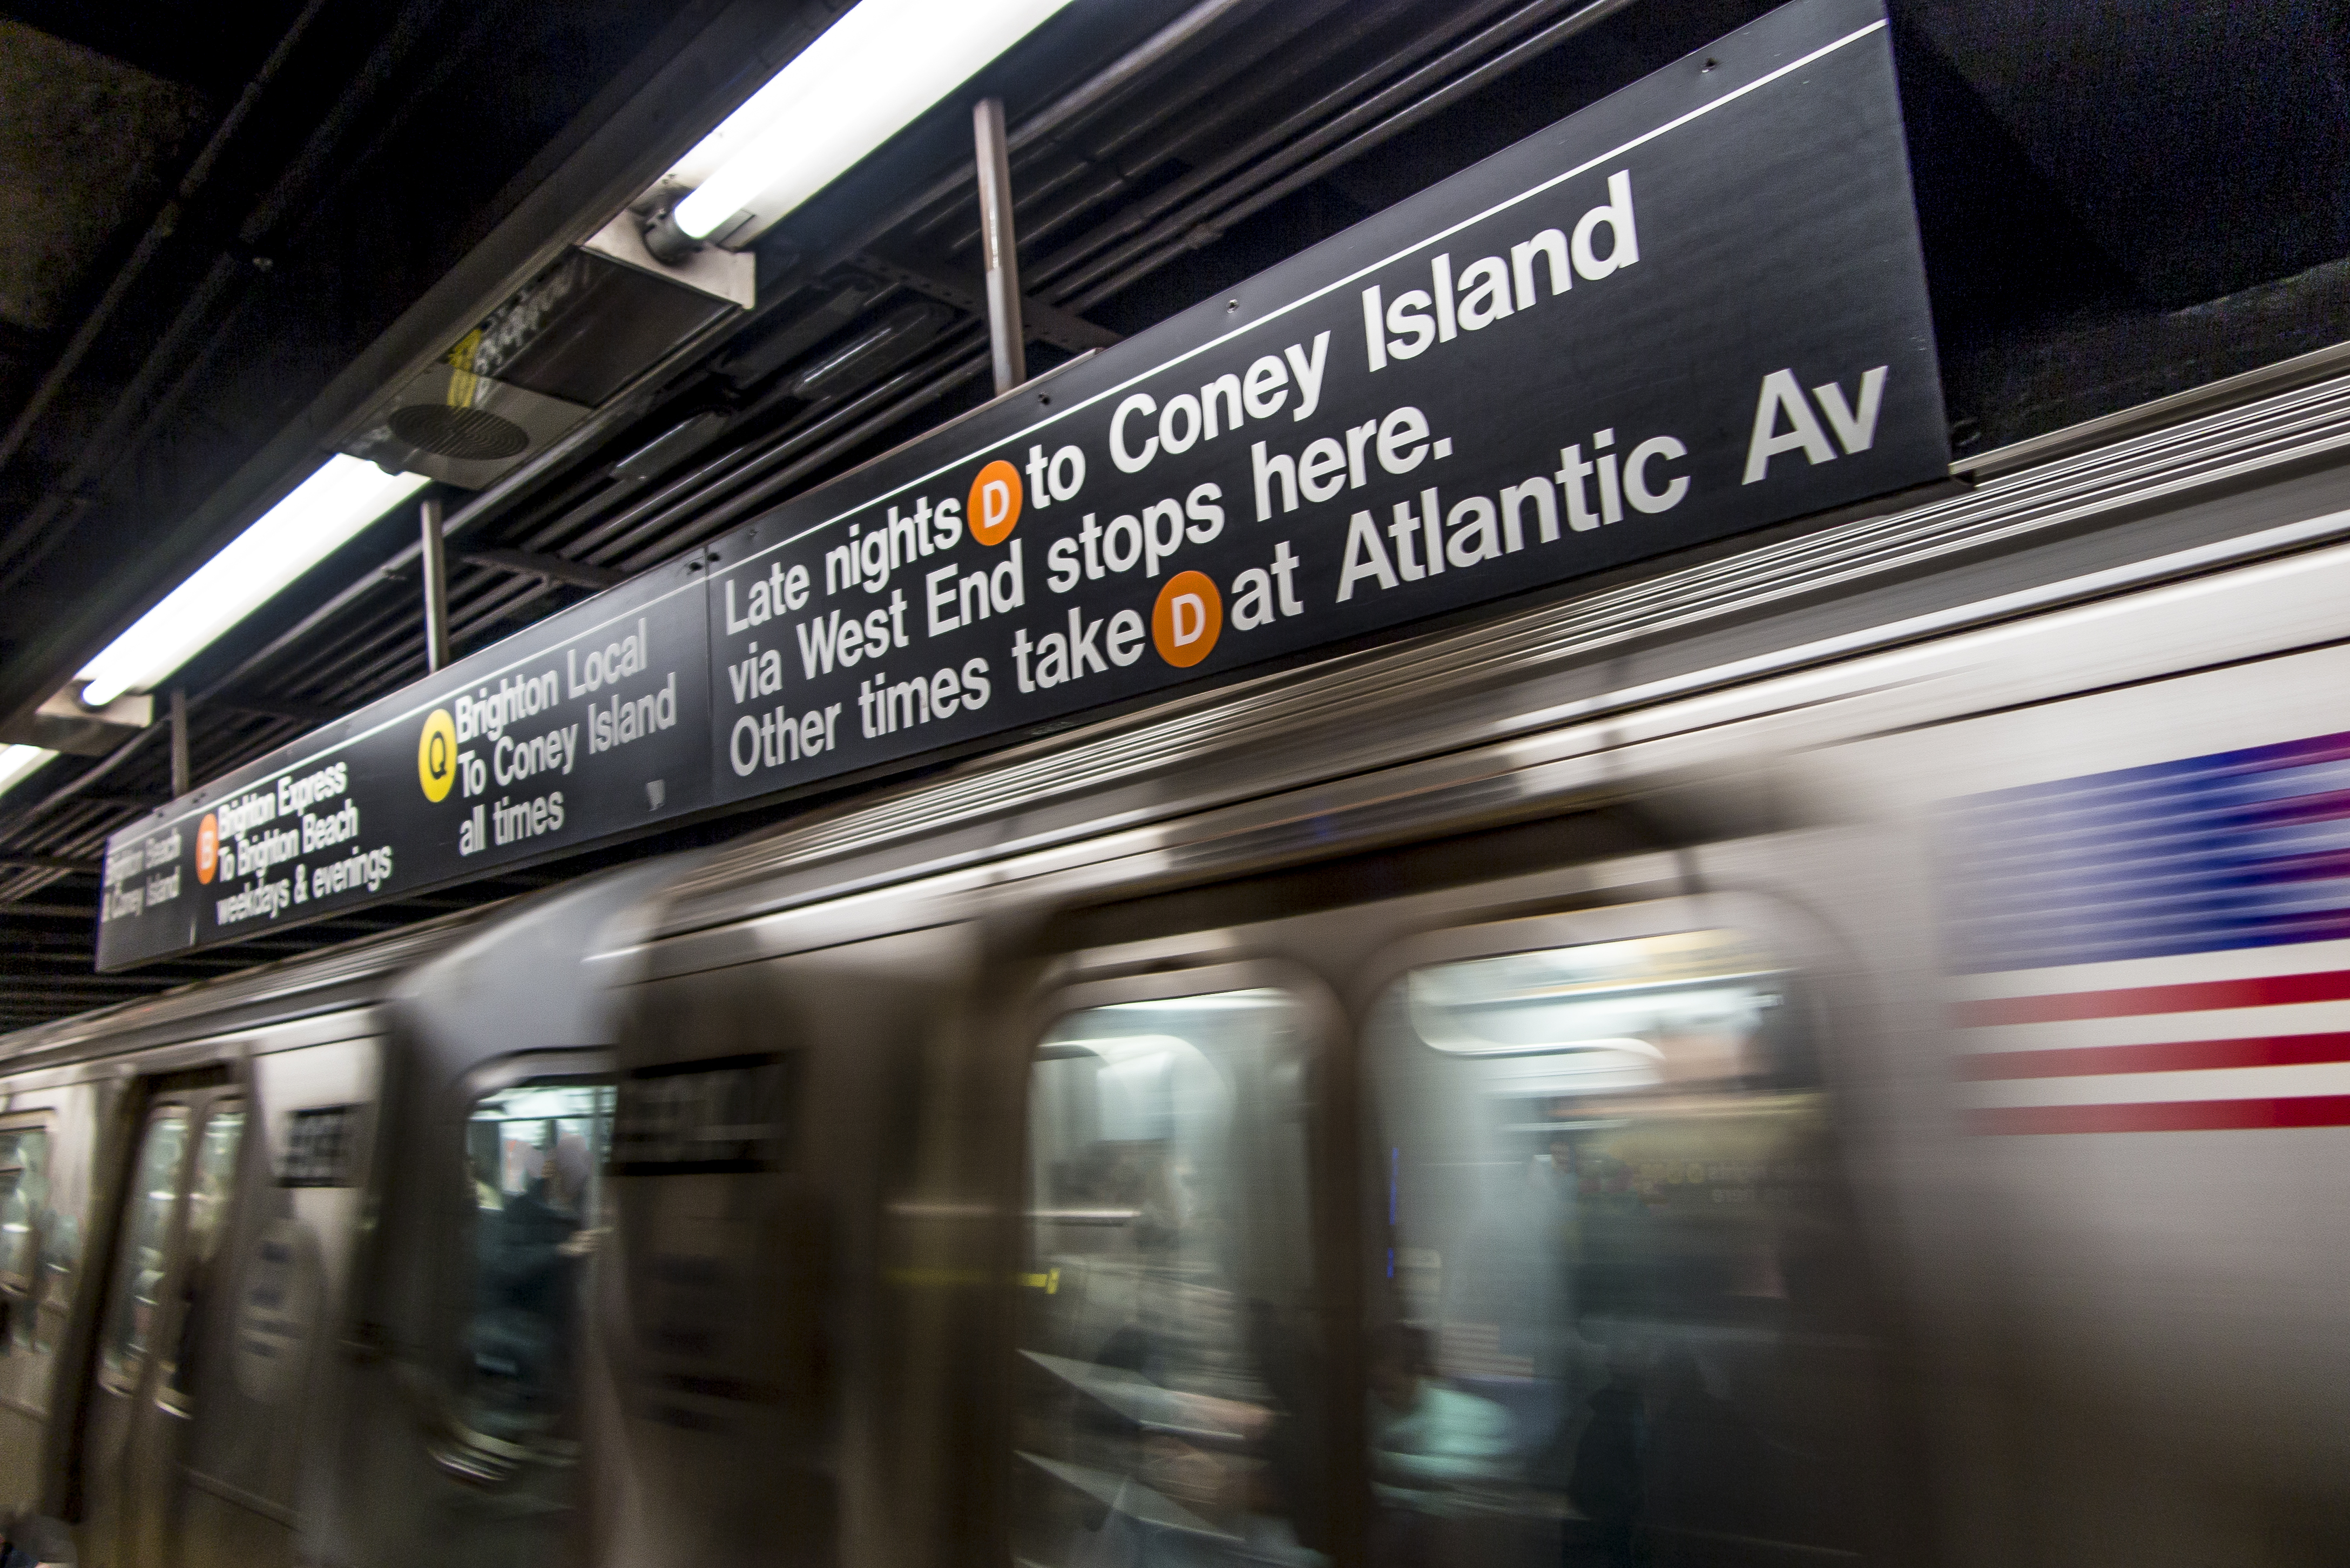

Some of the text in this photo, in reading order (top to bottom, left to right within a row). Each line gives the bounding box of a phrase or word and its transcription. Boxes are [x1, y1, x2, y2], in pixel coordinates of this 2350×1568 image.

[725, 169, 1640, 636] Late nights D to Coney Island
[728, 406, 1453, 704] via West End stops here.
[730, 365, 1888, 777] Other times take D at Atlantic Av
[429, 617, 647, 780] Q Brighton Local
[457, 671, 677, 799] To Coney Island
[200, 761, 348, 870] B Brighton Express
[218, 798, 359, 882] To Brighton Beach
[459, 791, 564, 856] all times
[217, 846, 393, 926] weekdays & evenings
